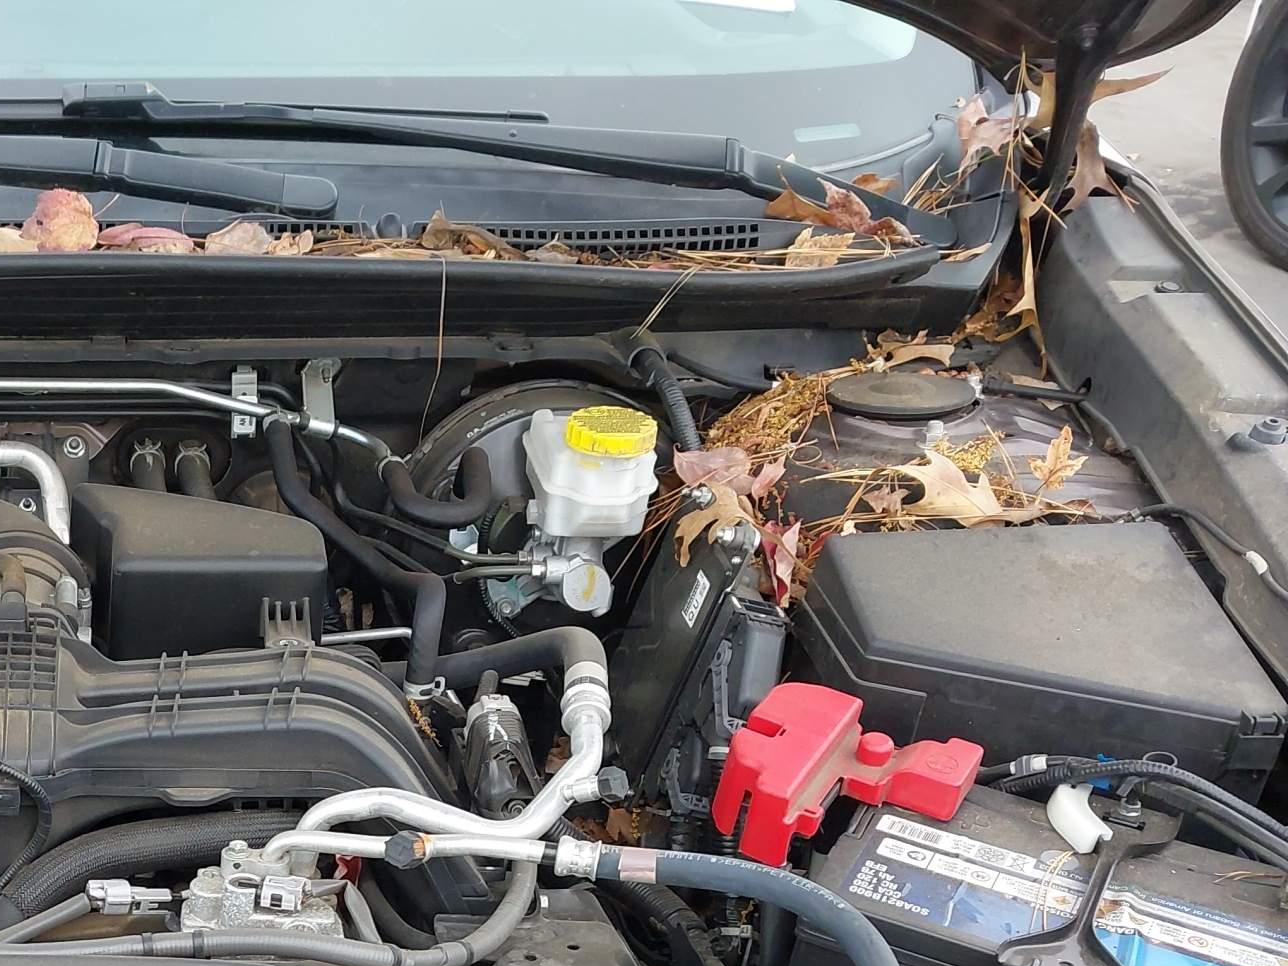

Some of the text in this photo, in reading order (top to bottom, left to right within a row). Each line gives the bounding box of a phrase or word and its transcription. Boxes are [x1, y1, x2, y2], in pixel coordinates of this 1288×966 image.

[857, 872, 899, 891] RC 120
[879, 871, 895, 882] Ah
[875, 883, 903, 900] CCA
